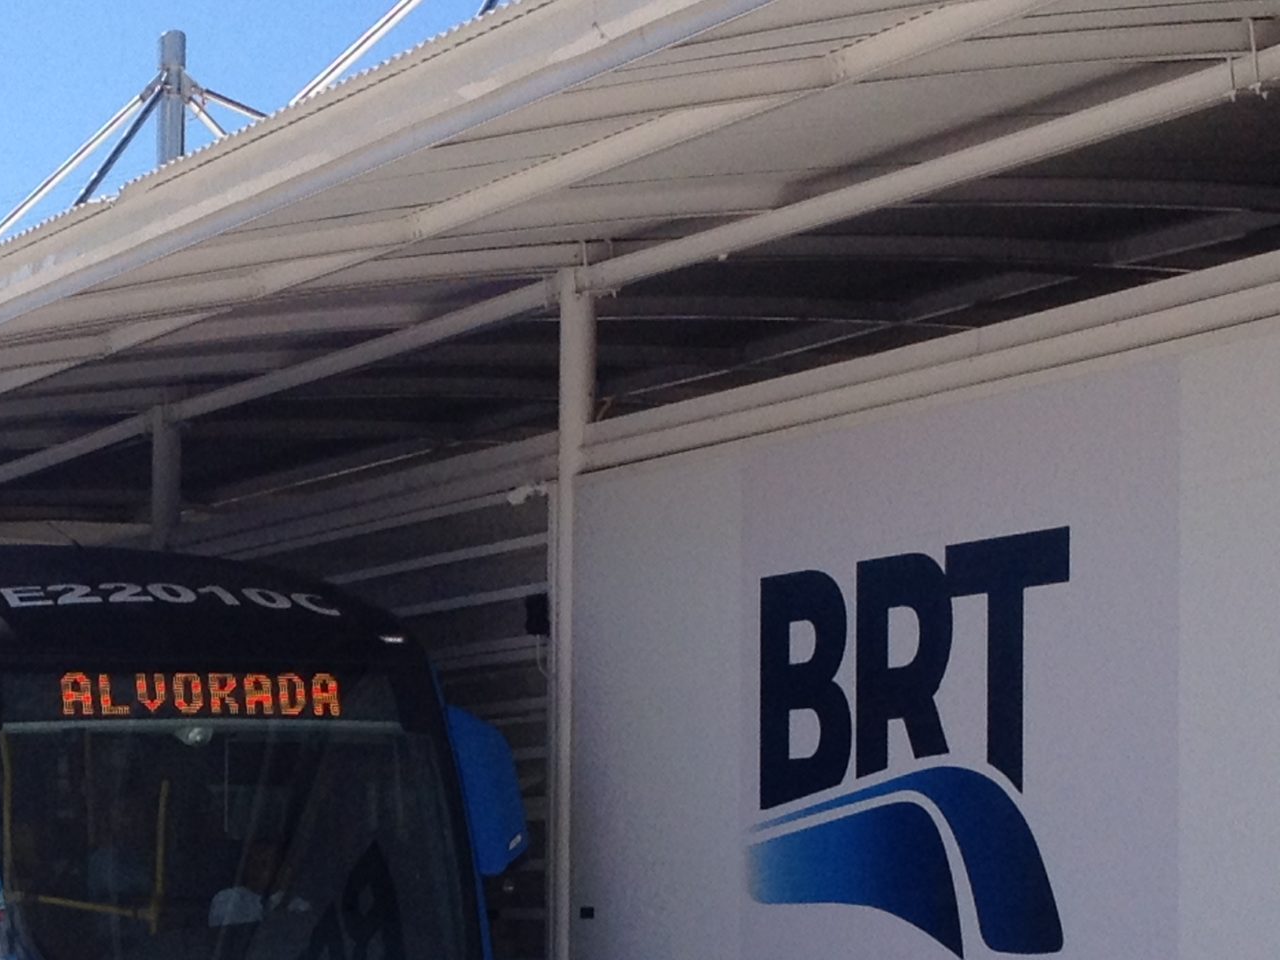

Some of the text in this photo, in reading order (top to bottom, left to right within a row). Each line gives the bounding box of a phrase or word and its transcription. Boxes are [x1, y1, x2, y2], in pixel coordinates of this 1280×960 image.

[0, 582, 342, 617] E22010C
[760, 526, 1070, 811] BRT
[60, 671, 342, 717] ALVORADA
